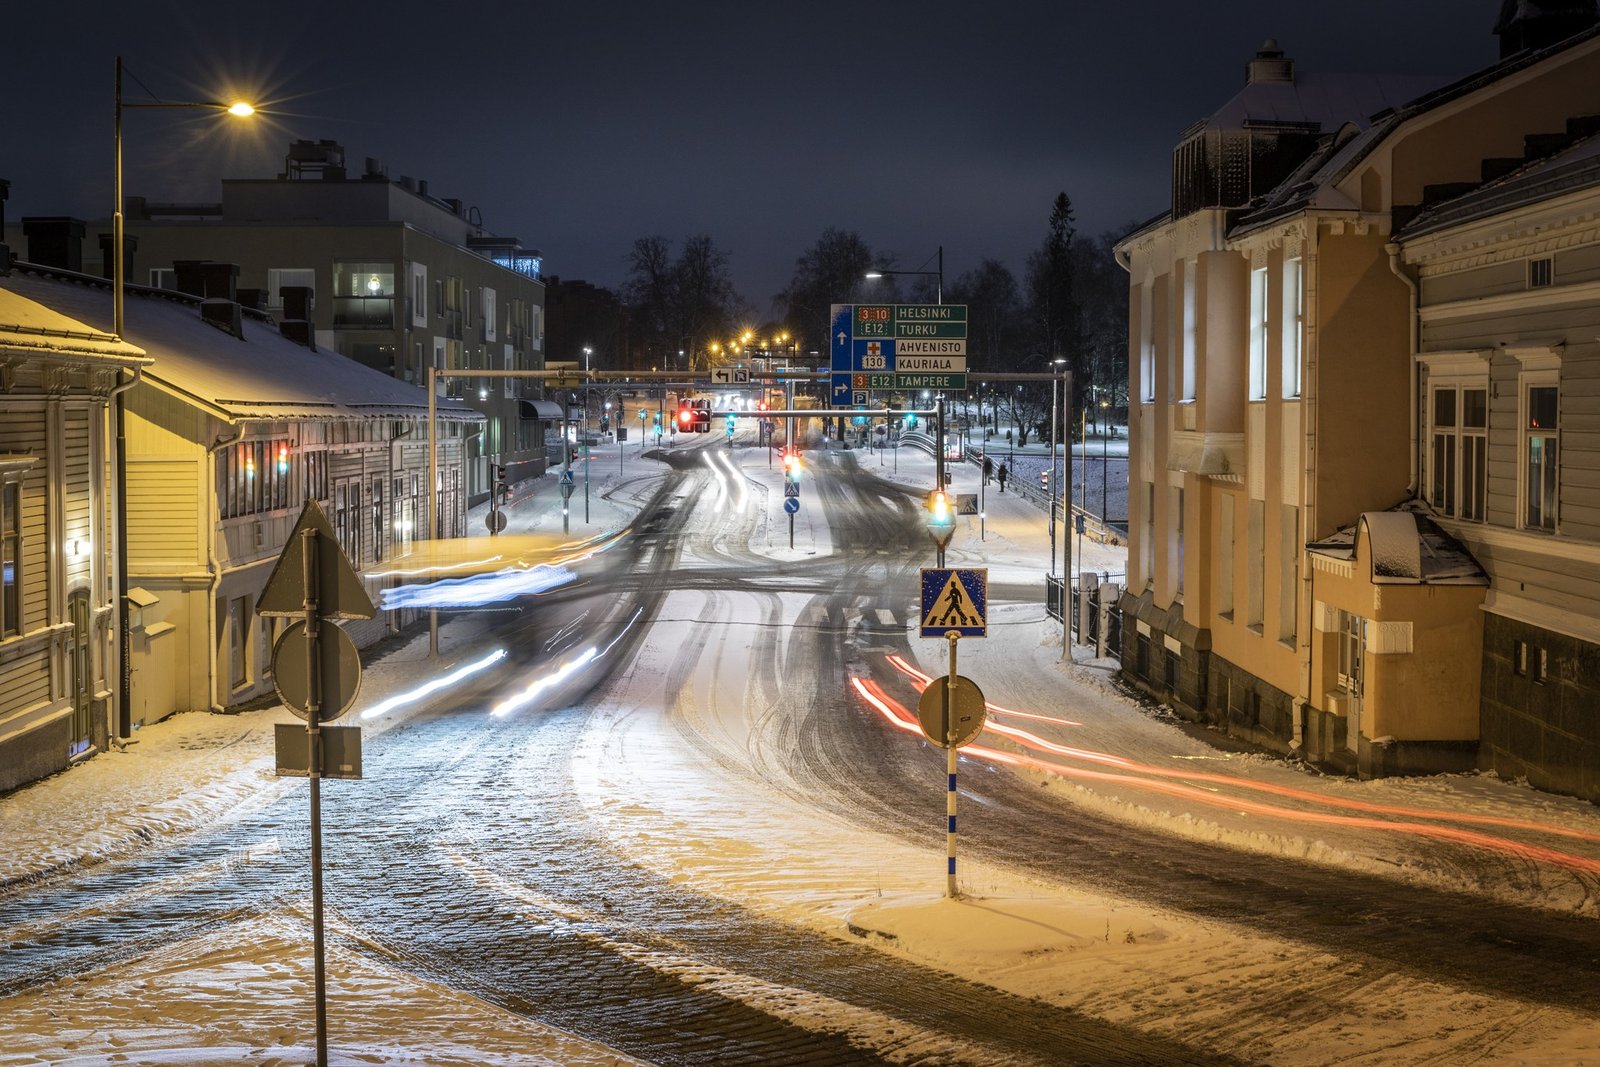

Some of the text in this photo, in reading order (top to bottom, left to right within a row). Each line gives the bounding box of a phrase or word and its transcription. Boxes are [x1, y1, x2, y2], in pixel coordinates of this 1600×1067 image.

[862, 309, 887, 319] 3 10
[899, 308, 951, 319] HELSINKI
[865, 323, 884, 333] E12
[900, 325, 937, 335] TURKU
[899, 342, 961, 353] AHVENISTO
[865, 357, 883, 367] 130
[899, 359, 952, 369] KAURIALA
[857, 376, 890, 386] 3 E12
[899, 376, 950, 386] TAMPERE
